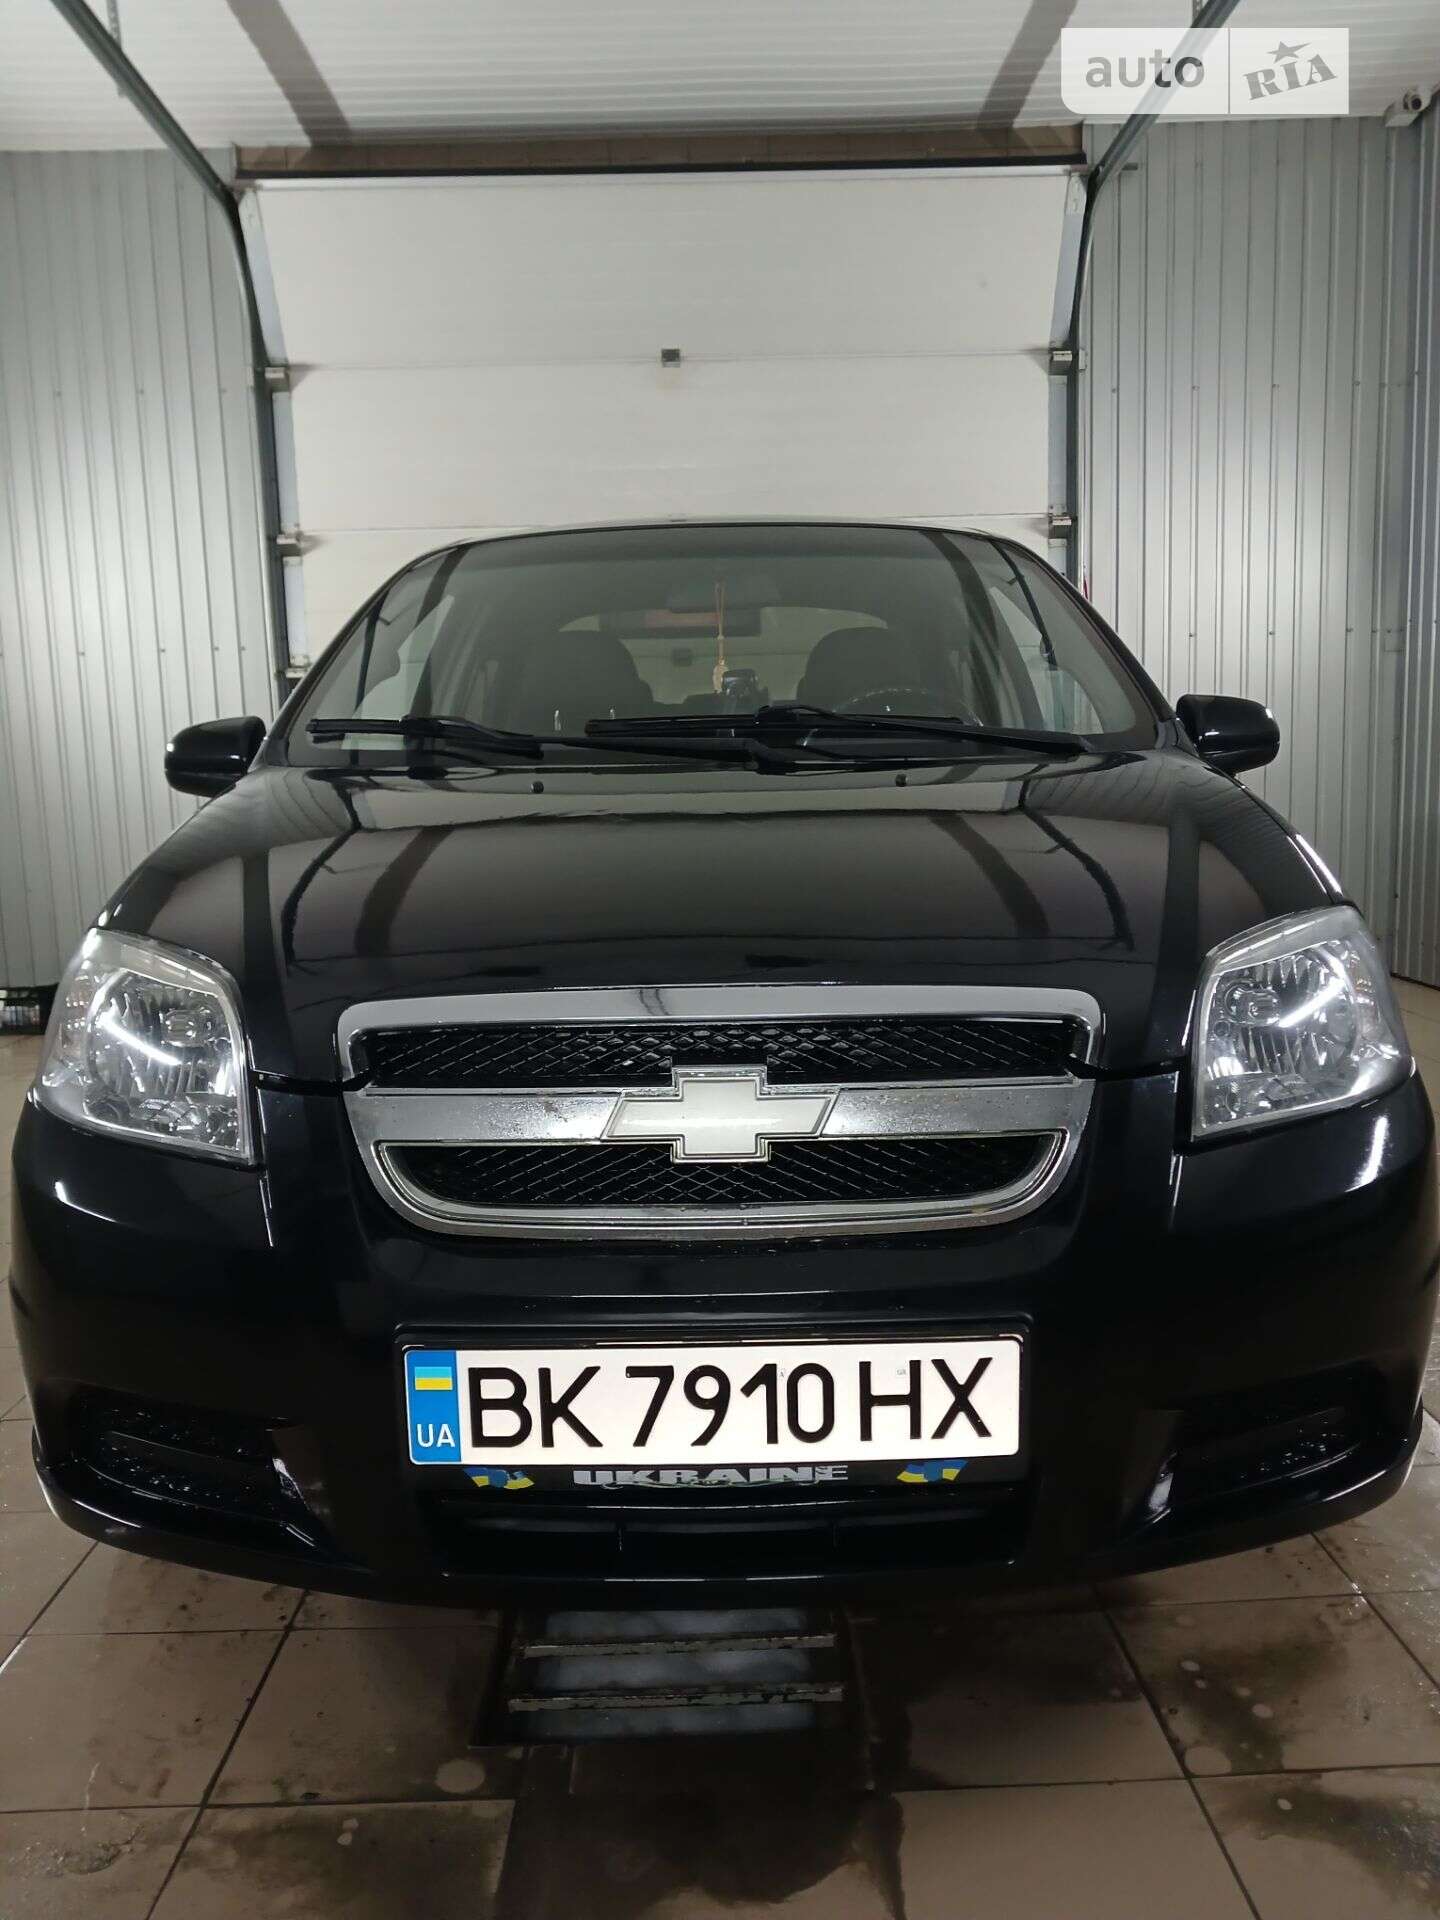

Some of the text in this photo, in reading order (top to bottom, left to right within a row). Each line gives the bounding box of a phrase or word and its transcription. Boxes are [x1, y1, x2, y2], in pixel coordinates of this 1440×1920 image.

[467, 1357, 994, 1448] BK 7910 HX
[417, 1424, 456, 1448] UA
[573, 1464, 849, 1486] UKRAINE
